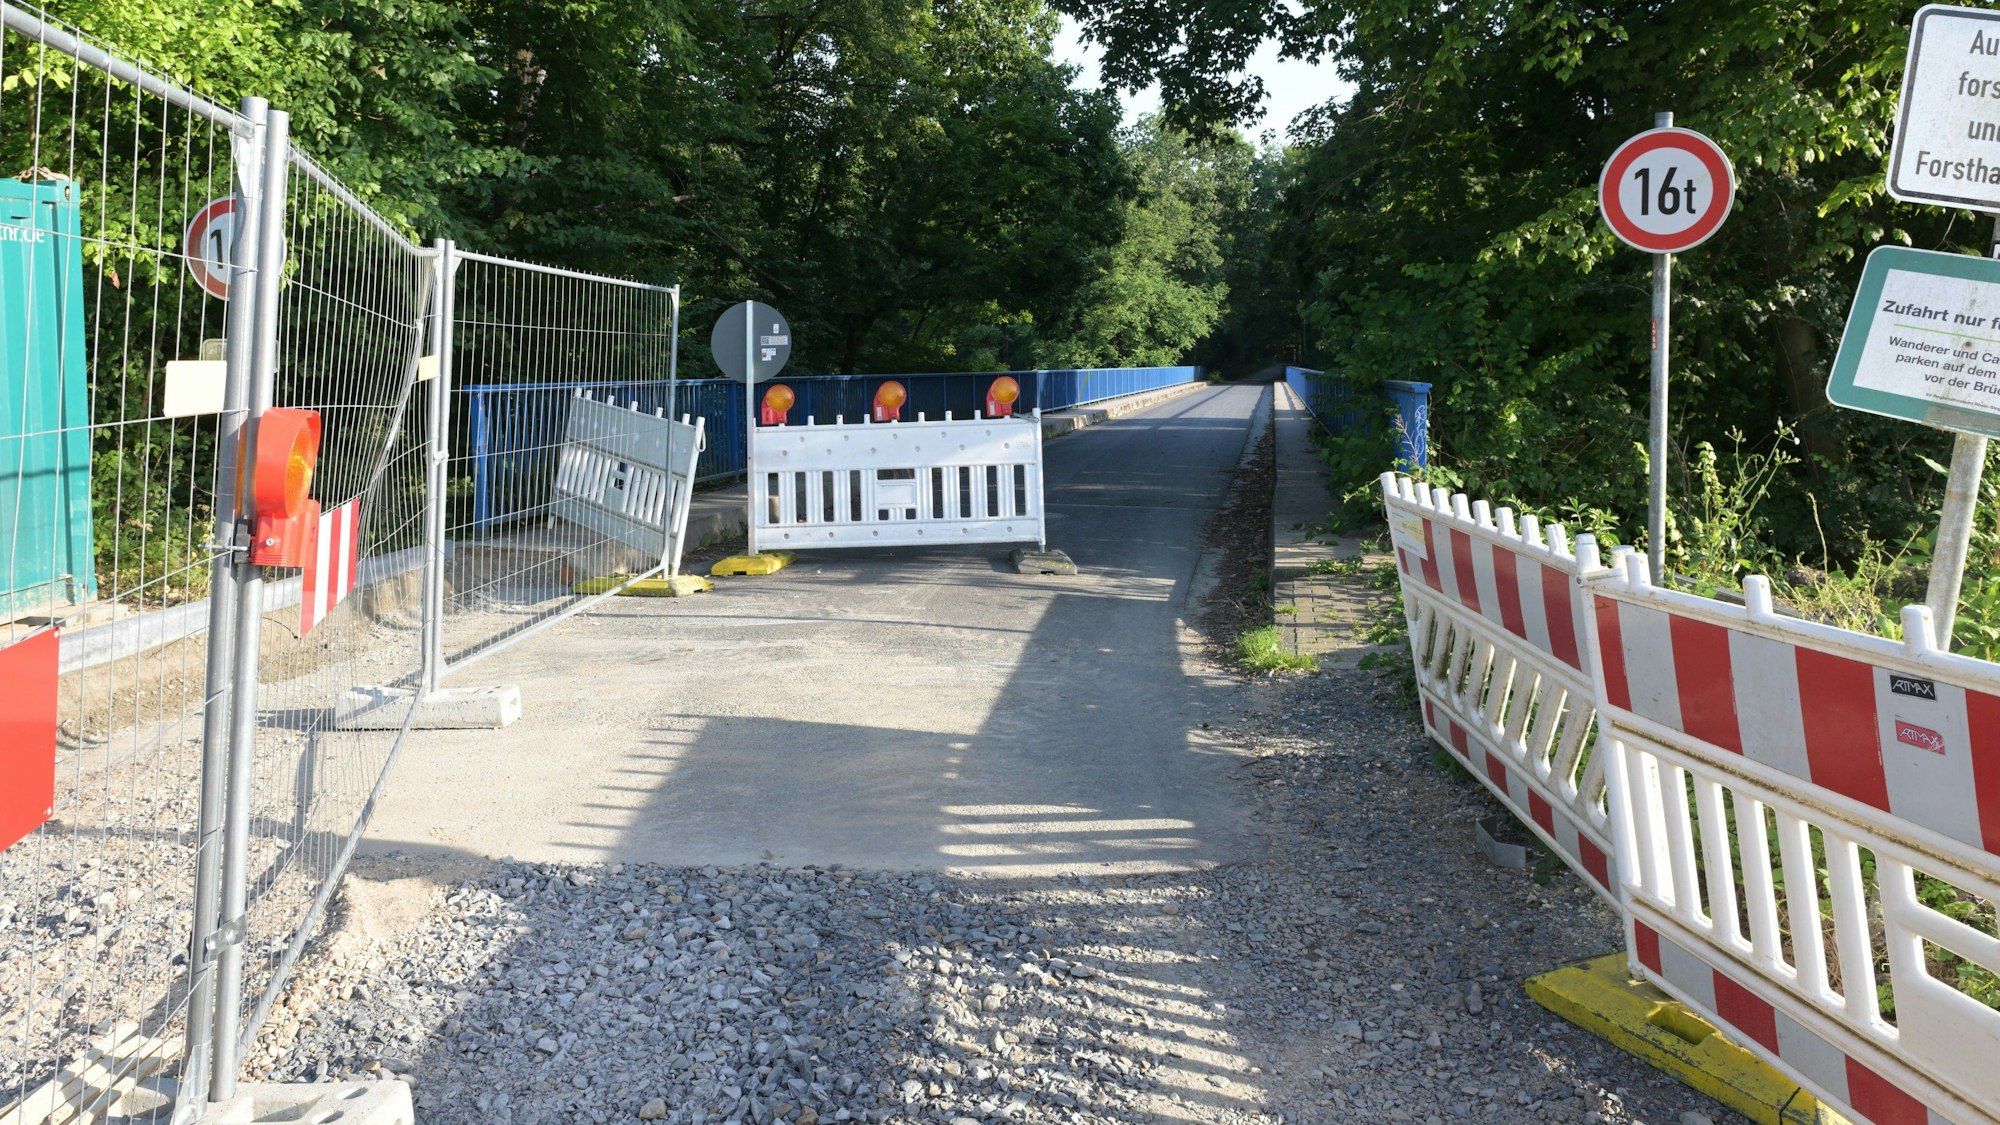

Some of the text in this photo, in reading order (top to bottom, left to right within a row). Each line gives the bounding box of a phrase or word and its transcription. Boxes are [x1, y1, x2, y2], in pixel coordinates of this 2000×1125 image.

[1958, 70, 2000, 99] fors
[1915, 150, 2000, 185] Forstha
[1634, 167, 1696, 215] 16t
[1882, 300, 1949, 321] Zufahrt
[1953, 313, 1986, 327] nur
[1889, 336, 1950, 355] Wanderer
[1952, 349, 1978, 360] und
[1895, 354, 1997, 379] parken auf dem
[1924, 373, 1946, 384] vor
[1948, 377, 1971, 389] der
